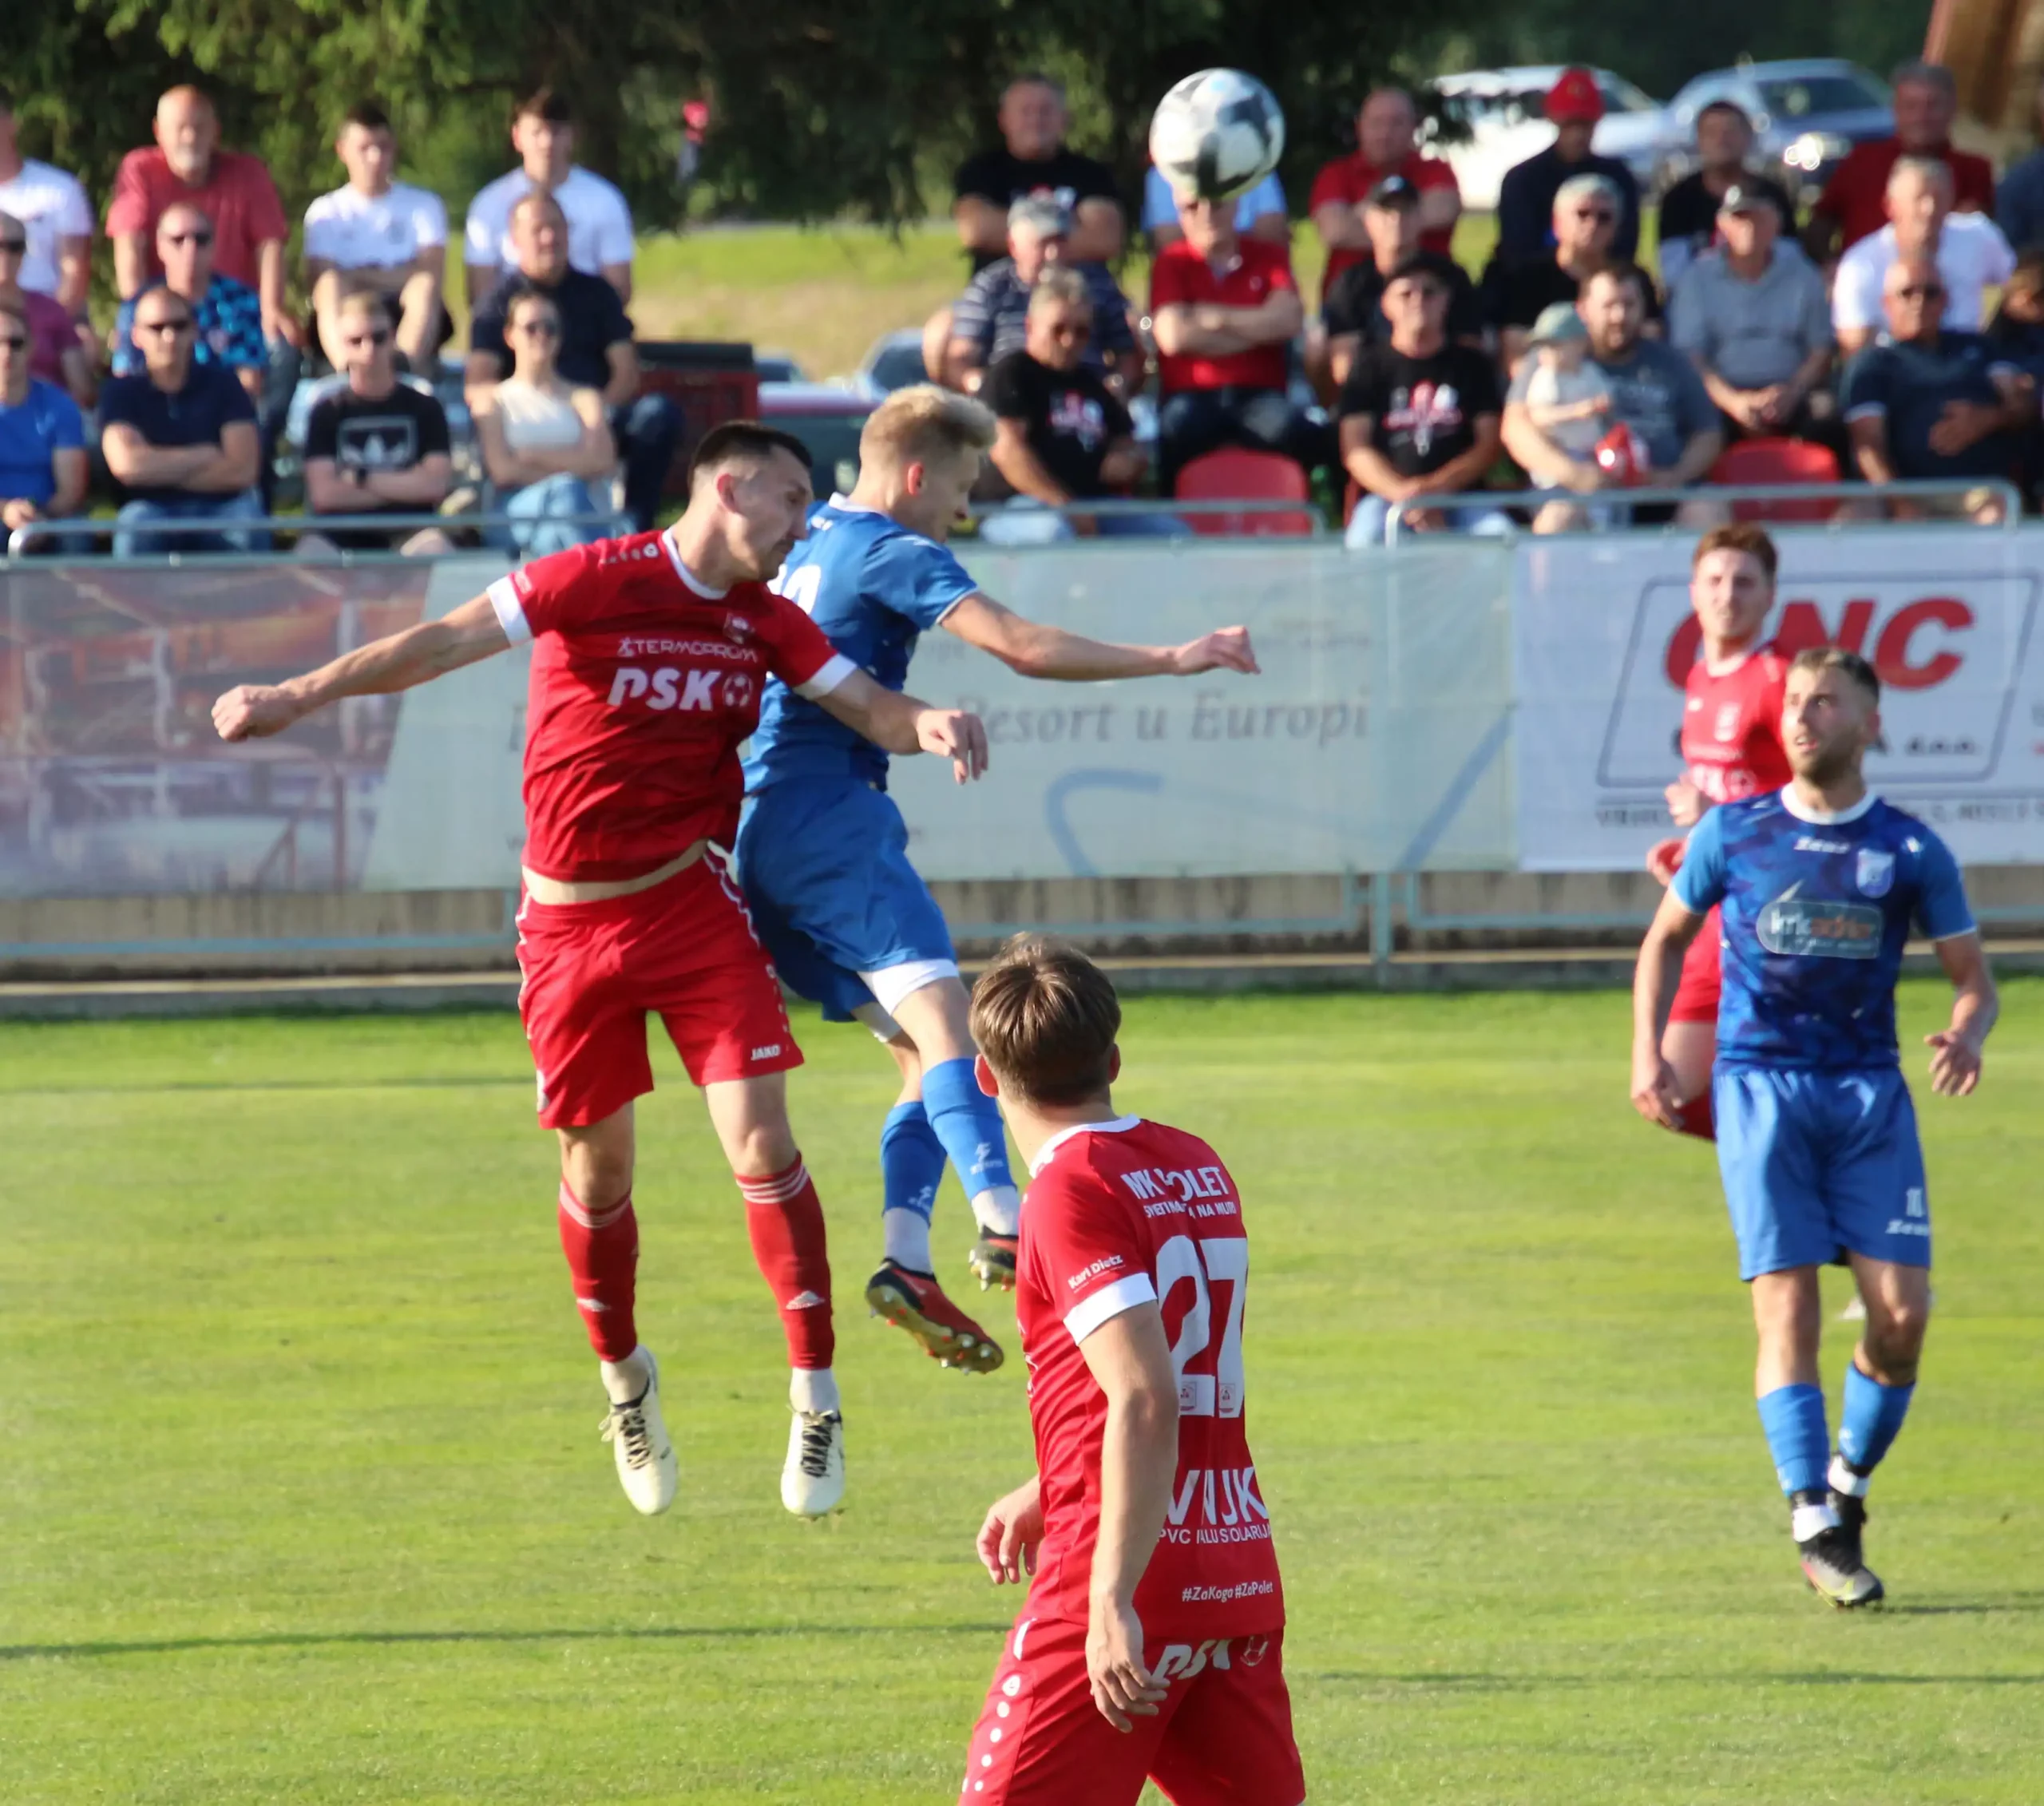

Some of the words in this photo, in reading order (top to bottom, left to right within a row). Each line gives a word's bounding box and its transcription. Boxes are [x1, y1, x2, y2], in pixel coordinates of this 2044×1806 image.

[607, 667, 721, 711] PSK
[1135, 703, 1168, 743] u
[1190, 688, 1371, 751] Europi
[751, 1044, 781, 1061] JAKO
[1196, 1204, 1215, 1218] NA
[1068, 1267, 1091, 1289] Karl
[1156, 1235, 1248, 1418] 27
[1182, 1586, 1234, 1603] #ZaKoga
[1235, 1580, 1274, 1599] #ZaPolet
